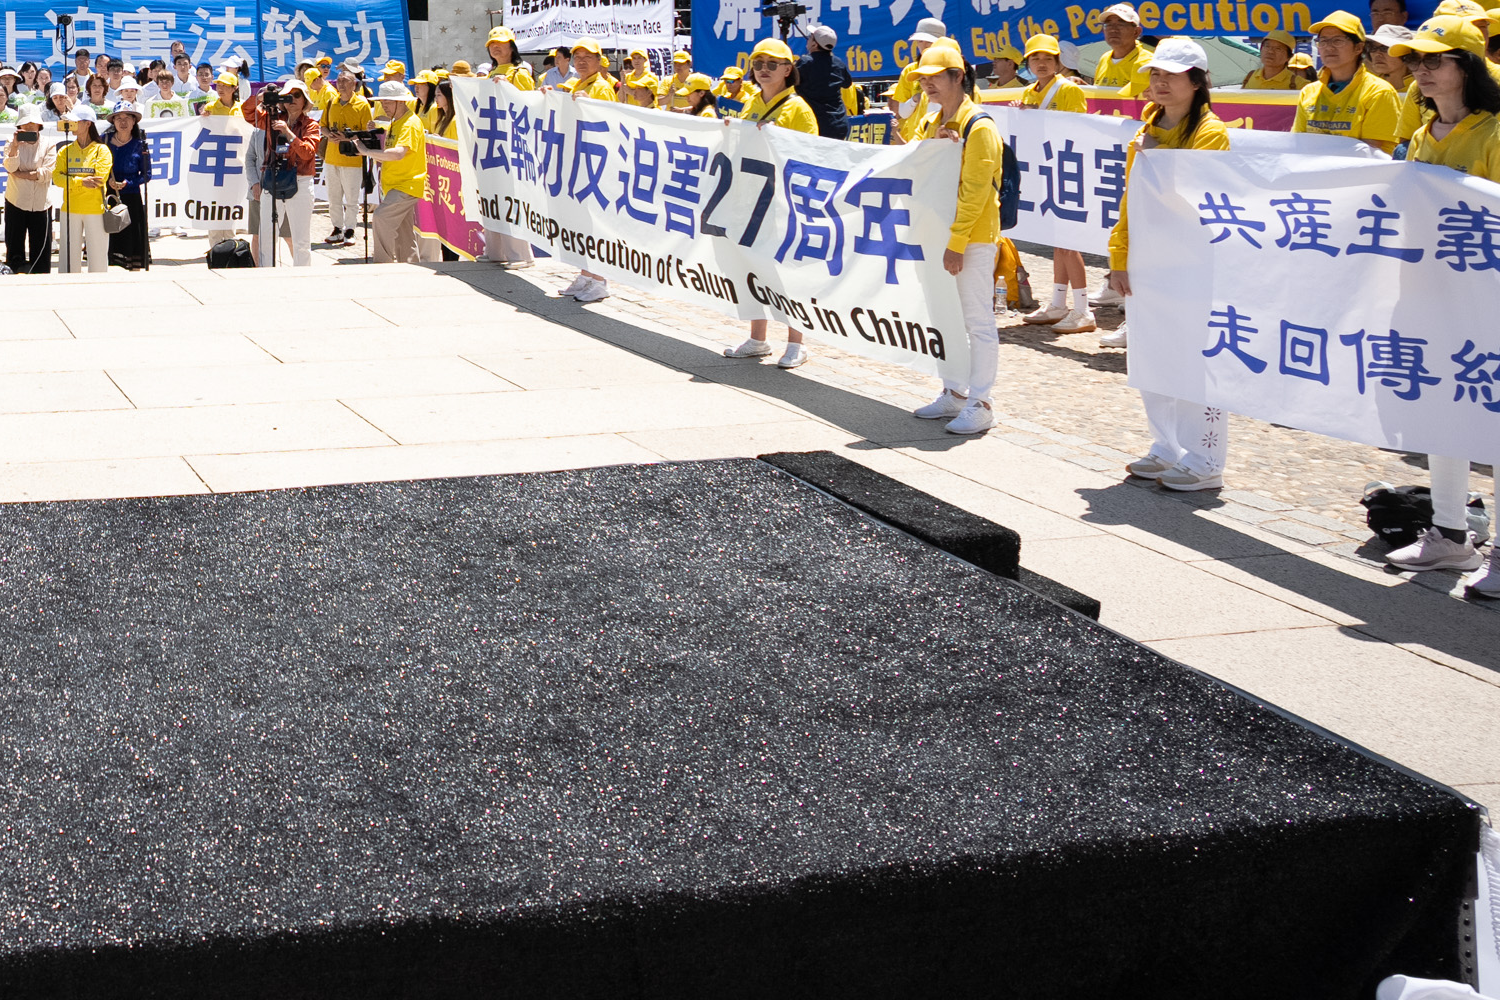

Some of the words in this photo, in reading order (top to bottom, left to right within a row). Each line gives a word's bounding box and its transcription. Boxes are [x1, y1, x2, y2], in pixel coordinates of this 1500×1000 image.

[643, 19, 661, 34] Race
[846, 45, 882, 72] the
[971, 22, 1010, 58] End
[155, 199, 177, 218] in
[184, 199, 244, 220] China
[468, 96, 924, 285] 法輪功反迫害27周年
[505, 195, 521, 226] 27
[550, 218, 652, 279] Persecution
[657, 254, 673, 286] of
[676, 258, 739, 304] Falun
[747, 272, 814, 330] Gong
[811, 298, 848, 337] in
[850, 307, 946, 361] China
